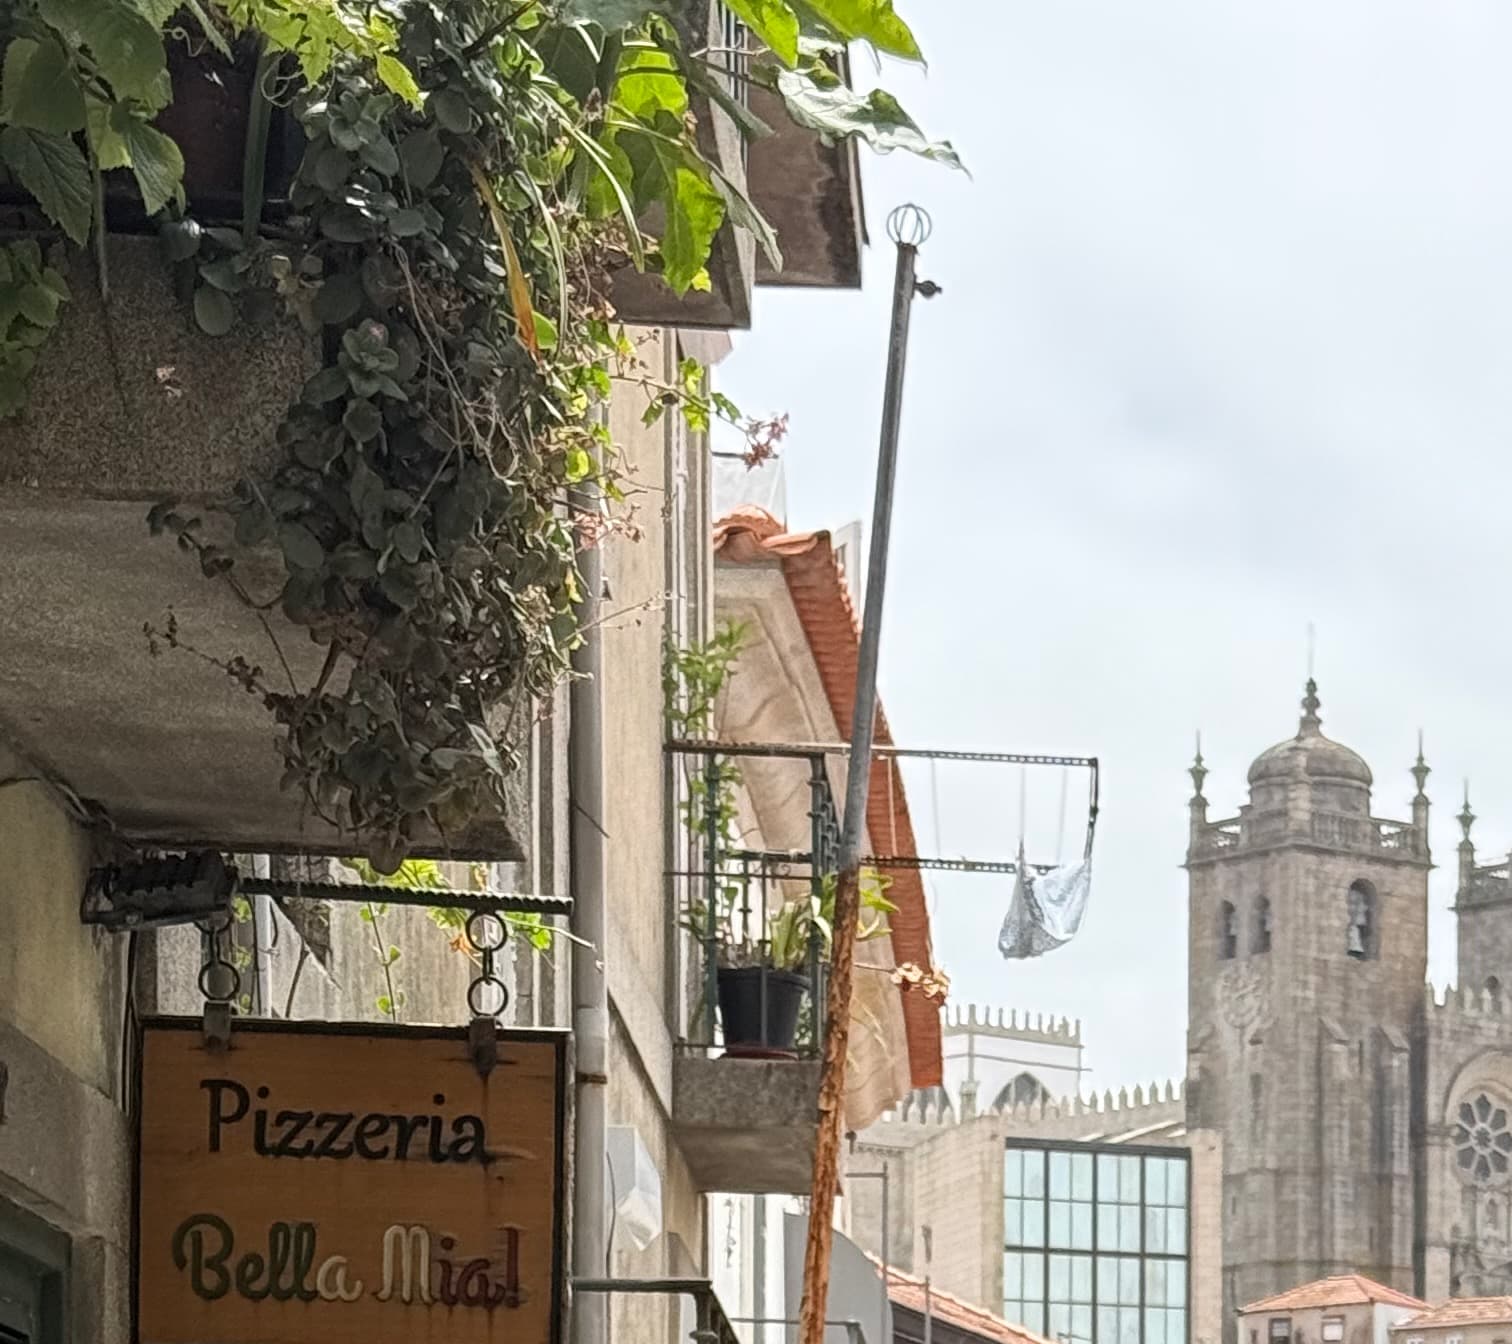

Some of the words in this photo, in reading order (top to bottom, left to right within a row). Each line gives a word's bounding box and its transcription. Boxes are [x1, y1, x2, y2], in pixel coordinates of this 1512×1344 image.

[201, 1078, 497, 1164] Pizzeria
[172, 1213, 362, 1302] Bella
[373, 1224, 521, 1307] Mia!
